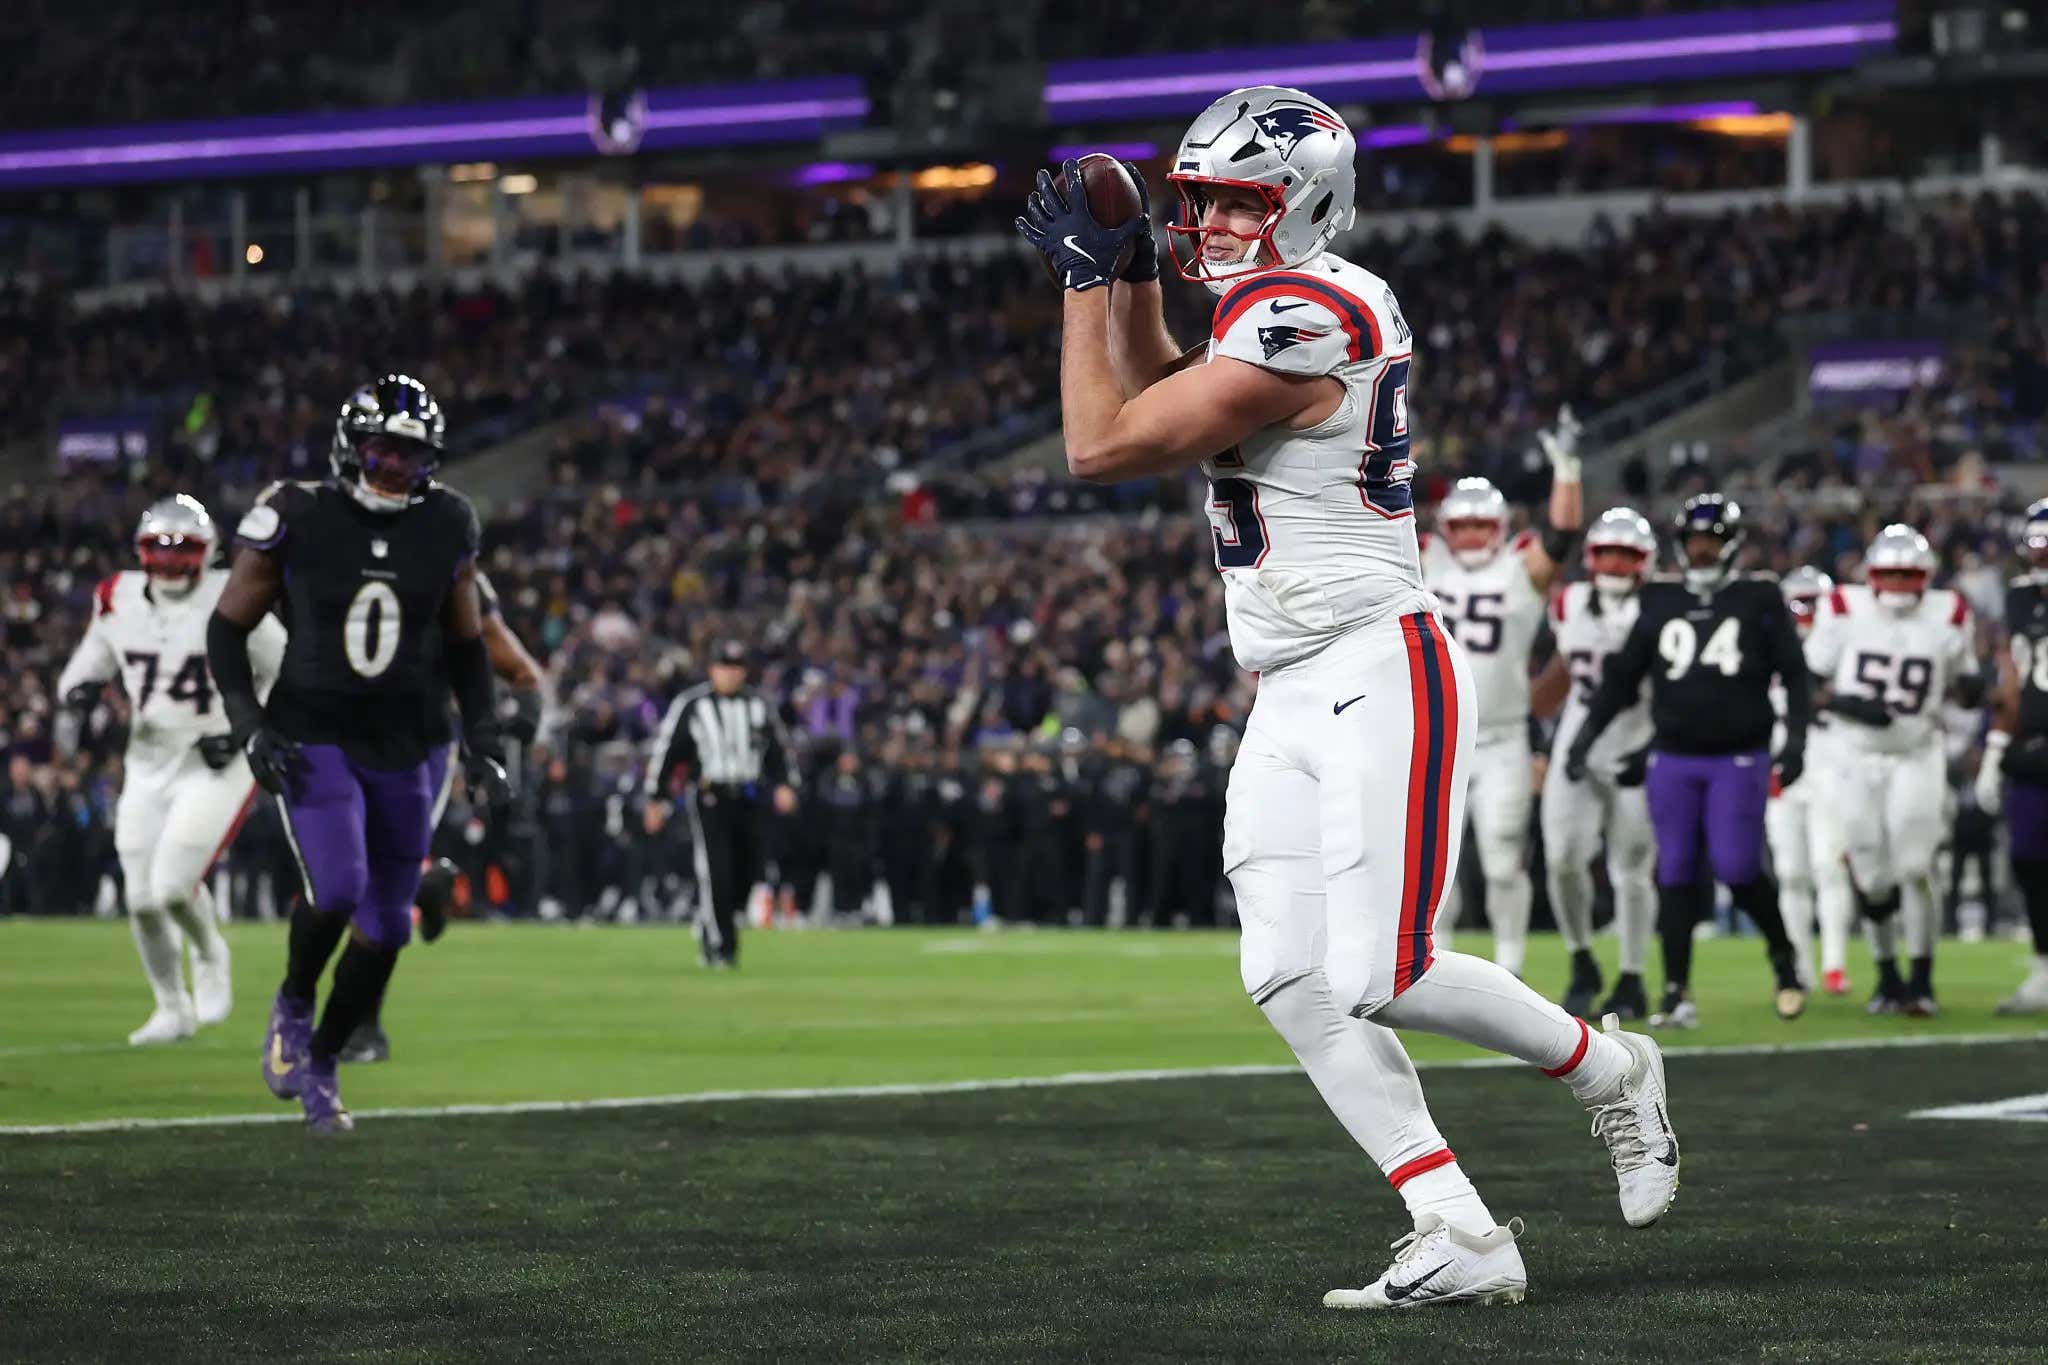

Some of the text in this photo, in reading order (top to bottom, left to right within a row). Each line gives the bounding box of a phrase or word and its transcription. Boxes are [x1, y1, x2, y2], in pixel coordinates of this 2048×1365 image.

[344, 581, 401, 678] 0
[1658, 616, 1744, 680] 94
[124, 651, 213, 715] 74
[1856, 652, 1932, 715] 59
